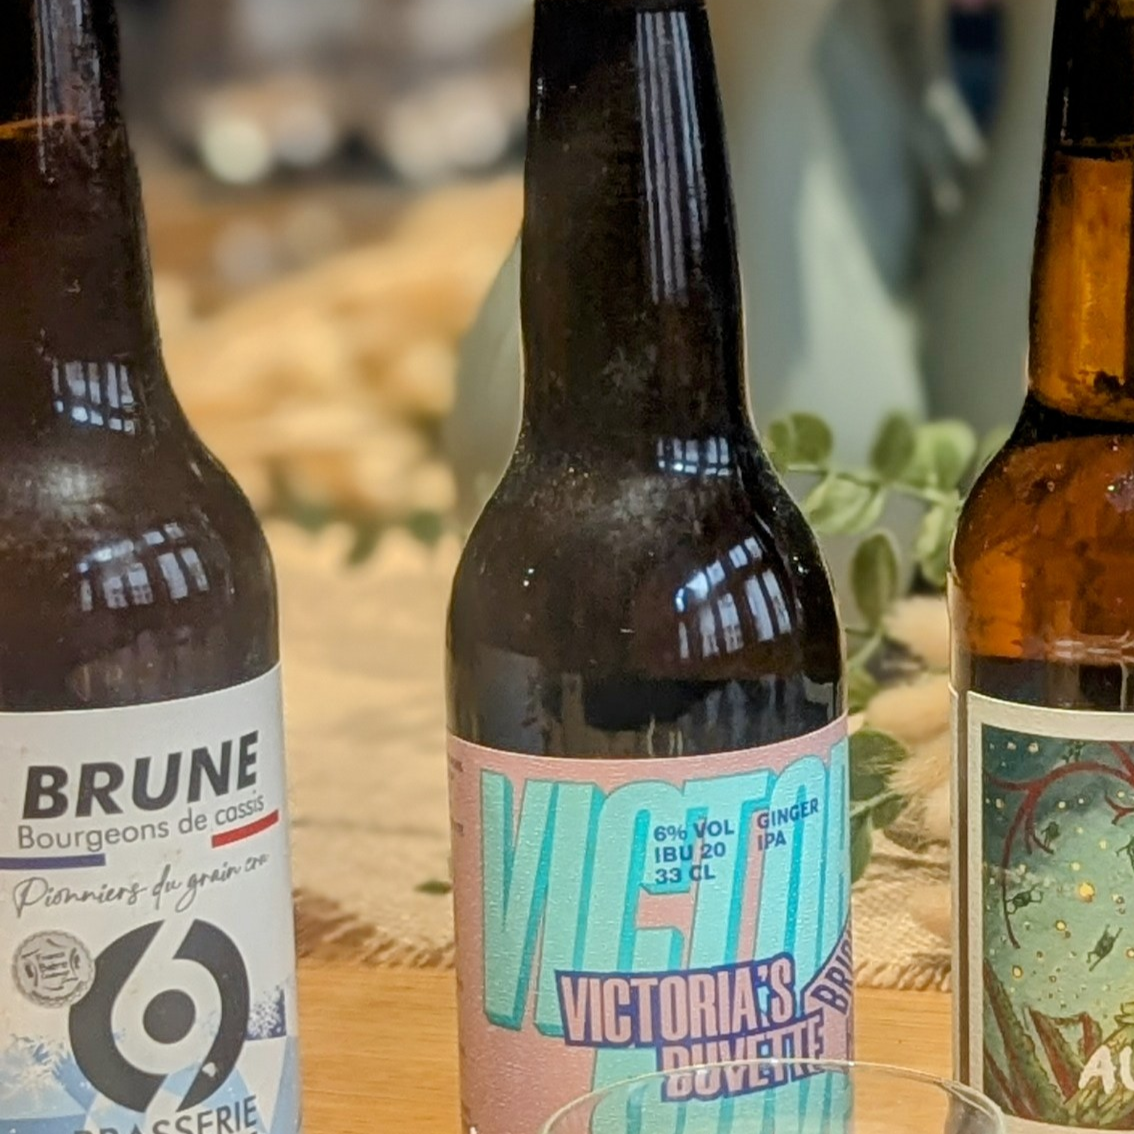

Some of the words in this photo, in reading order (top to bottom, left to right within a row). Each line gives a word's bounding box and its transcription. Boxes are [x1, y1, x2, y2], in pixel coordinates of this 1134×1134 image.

[22, 730, 259, 820] BRUNE
[18, 823, 169, 852] Bourgeons
[178, 808, 208, 834] de
[215, 790, 264, 826] cassis
[654, 825, 688, 842] 6%
[693, 819, 735, 839] VOL
[757, 797, 819, 829] GINGER
[757, 830, 787, 851] IPA
[655, 845, 693, 863] IBU
[701, 841, 726, 859] 20
[655, 867, 682, 885] 33
[688, 865, 716, 882] CL
[13, 876, 146, 918] Pionniers
[152, 864, 182, 910] du
[174, 862, 241, 913] grain
[480, 738, 851, 1036] VICTO
[561, 957, 794, 1044] VICTORIA'S
[662, 1016, 826, 1098] BUVETTE
